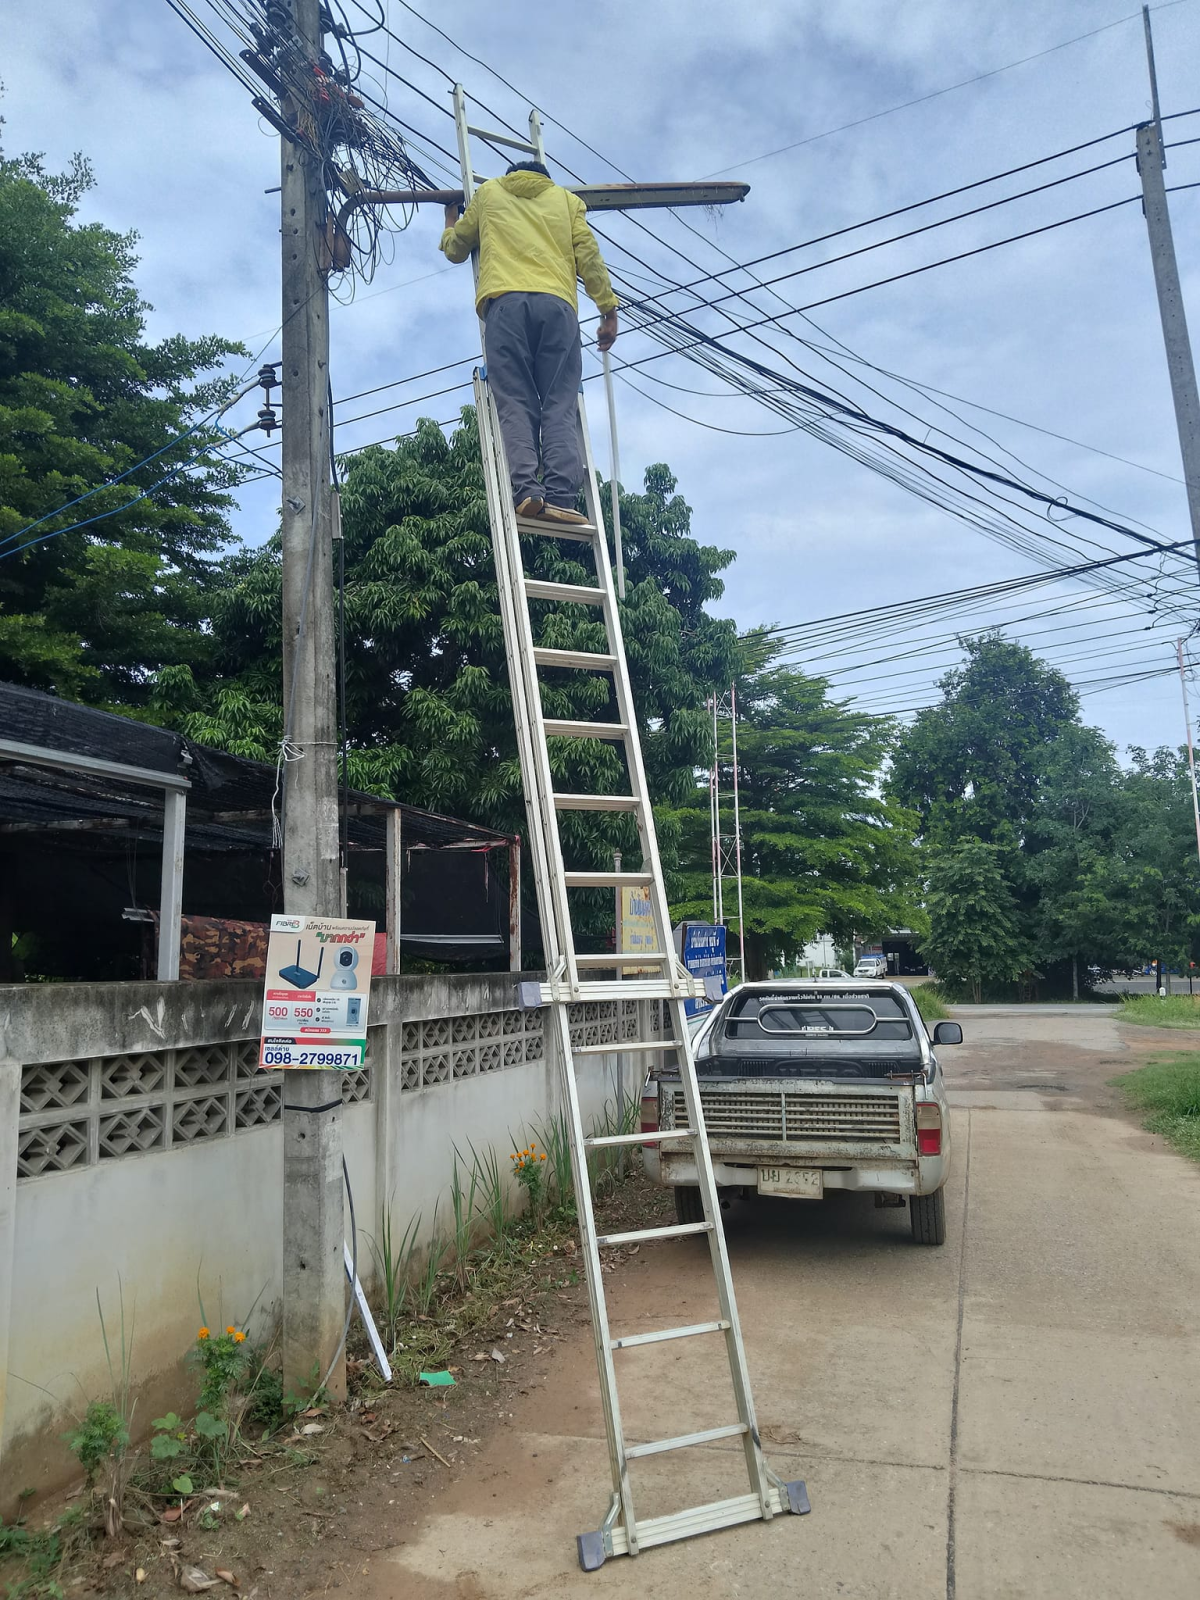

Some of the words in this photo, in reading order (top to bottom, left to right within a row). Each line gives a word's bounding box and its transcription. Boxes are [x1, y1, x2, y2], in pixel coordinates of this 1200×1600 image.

[306, 921, 332, 930] เน็ตบ้าน
[268, 1007, 288, 1016] 500
[294, 1008, 313, 1017] 550
[265, 1052, 358, 1065] 098-2799871
